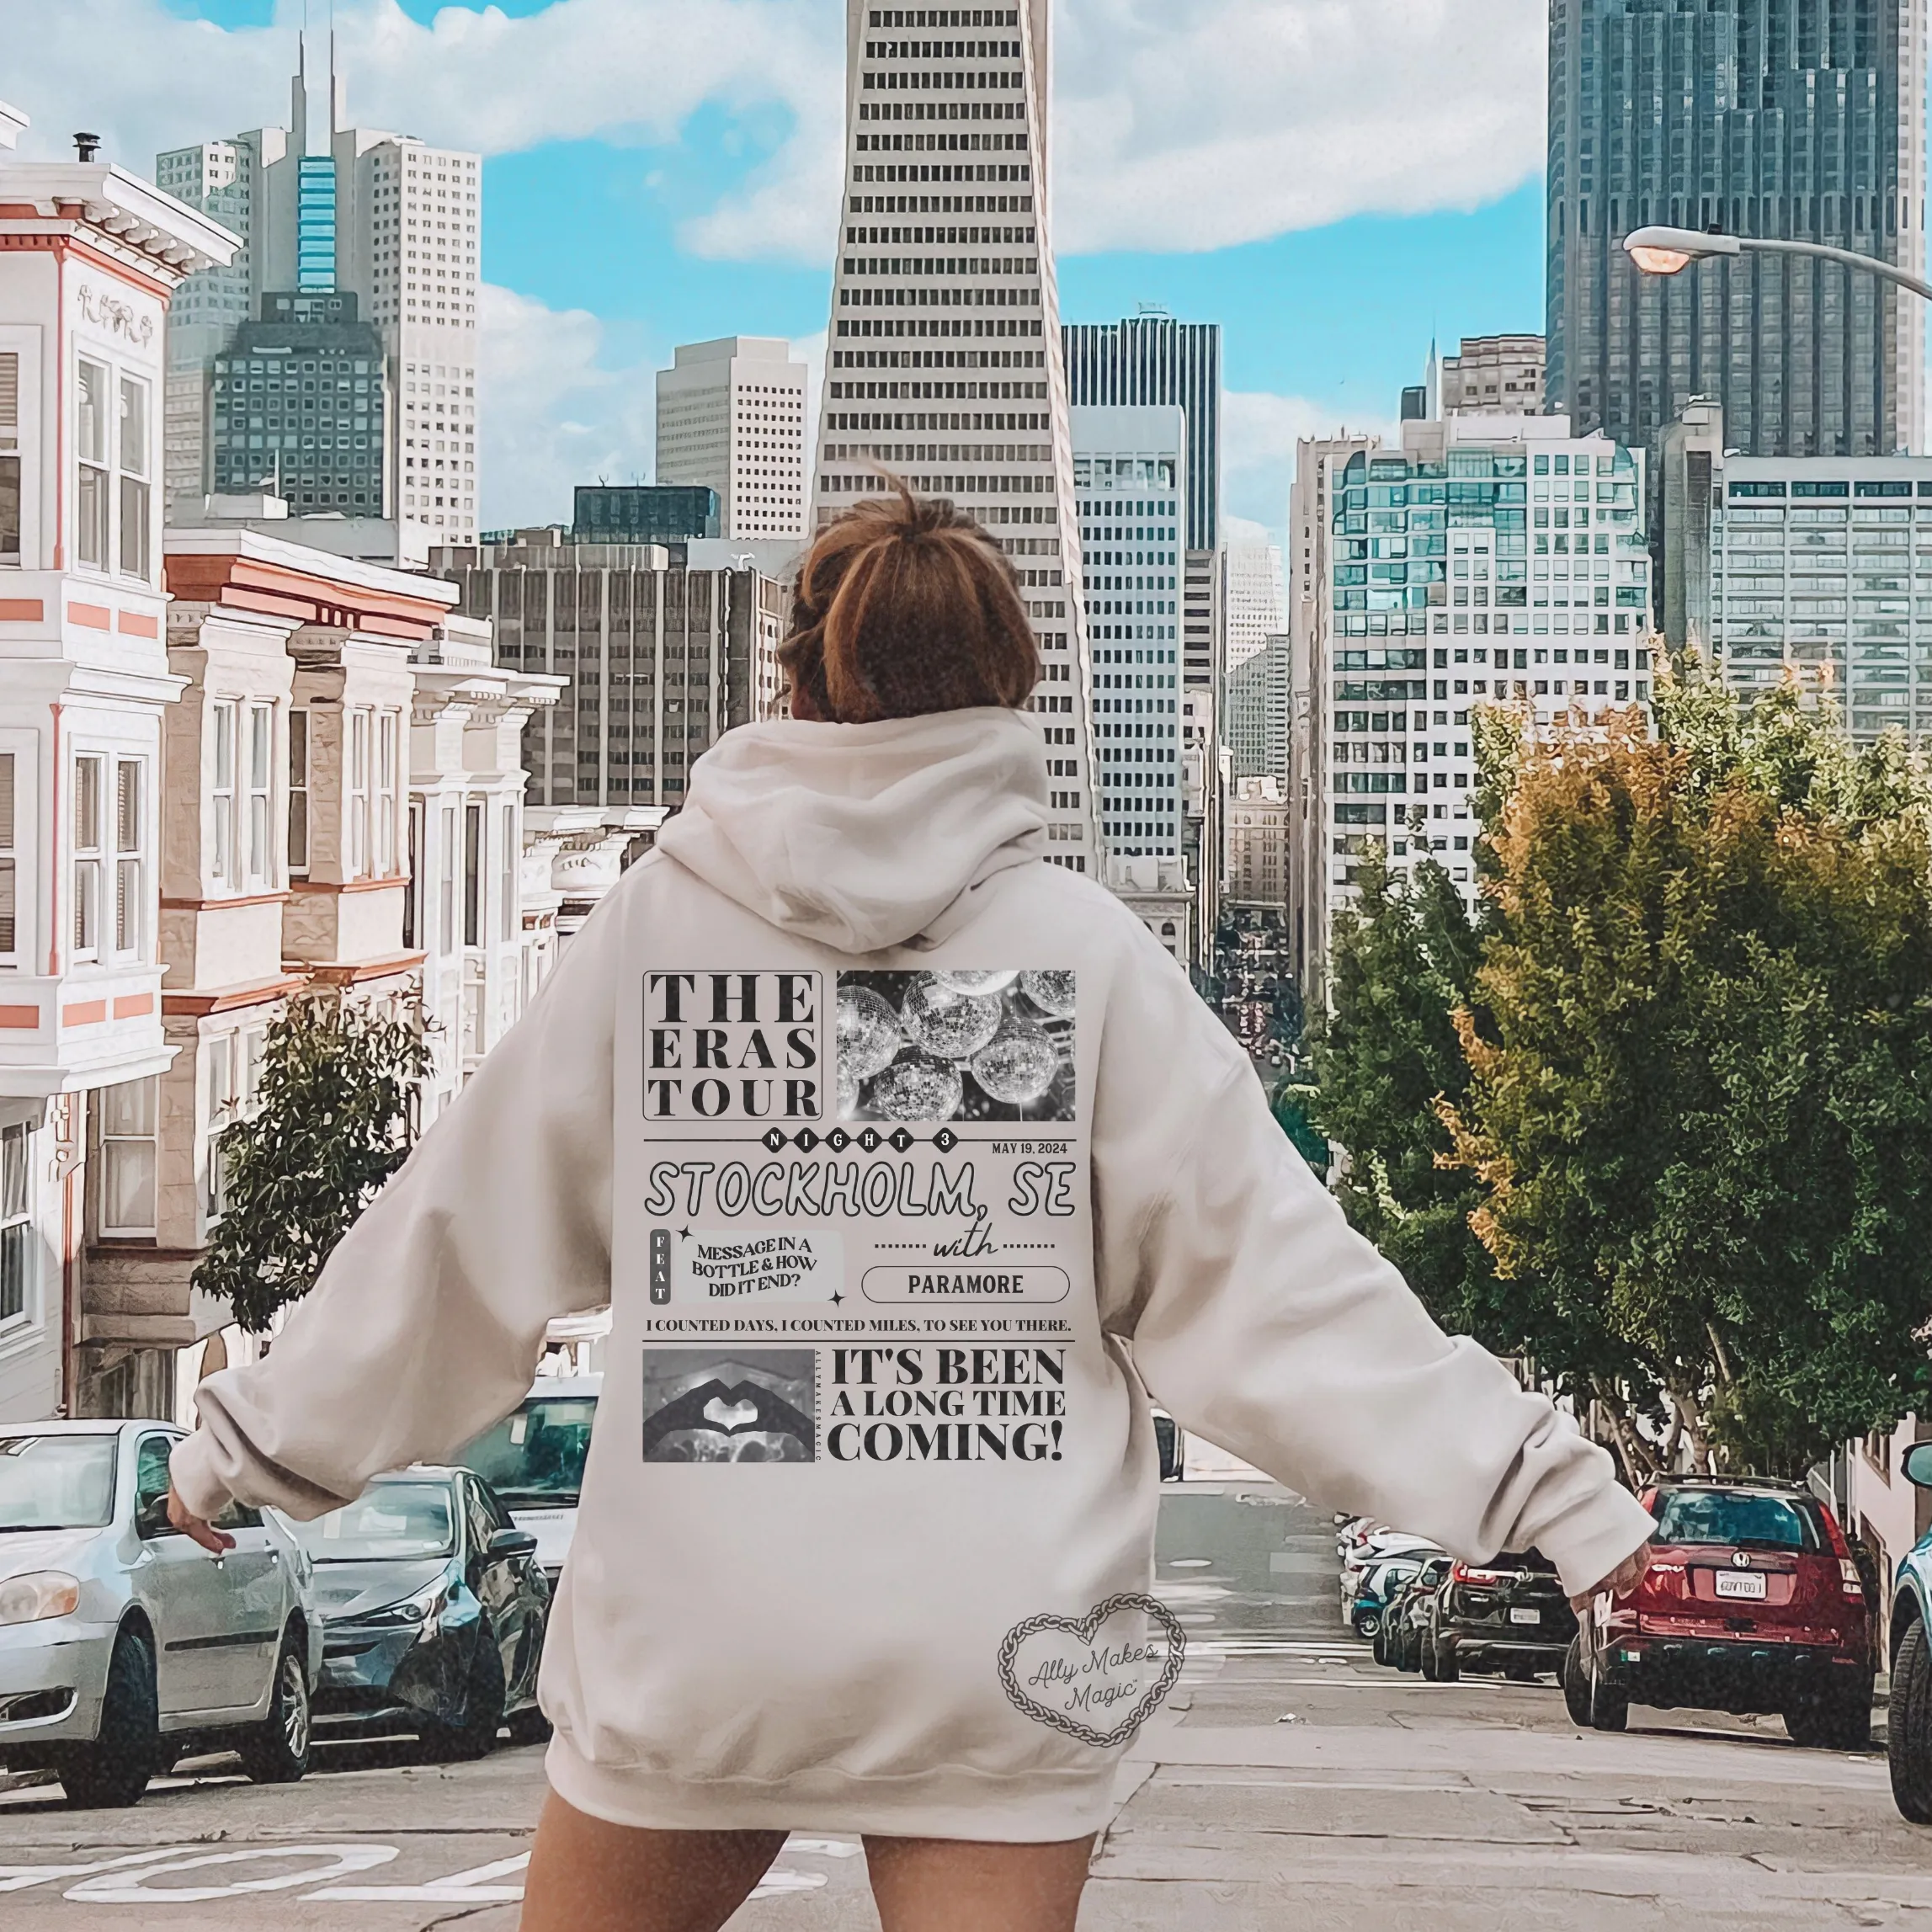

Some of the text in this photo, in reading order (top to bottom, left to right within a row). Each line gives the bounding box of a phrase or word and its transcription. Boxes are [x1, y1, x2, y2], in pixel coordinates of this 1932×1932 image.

[650, 974, 815, 1023] THE
[648, 1028, 817, 1070] ERAS
[647, 1078, 820, 1117] TOUR
[770, 1132, 950, 1147] NIGHT 3
[992, 1142, 1068, 1155] MAY 19, 2024
[644, 1161, 1077, 1222] STOCKHOLM, SE
[697, 1237, 812, 1260] MESSAGE IN A
[933, 1221, 999, 1258] with
[655, 1236, 666, 1299] FEAT
[692, 1254, 817, 1279] BOTTLE & HOW
[709, 1274, 801, 1297] DID IT END?
[908, 1275, 1025, 1295] PARAMORE
[646, 1319, 1072, 1333] I COUNTED DAYS, I COUNTED MILES, TO SEE YOU THERE.
[831, 1348, 1067, 1386] IT'S BEEN
[830, 1390, 1066, 1417] A LONG TIME
[827, 1419, 1064, 1461] COMING!
